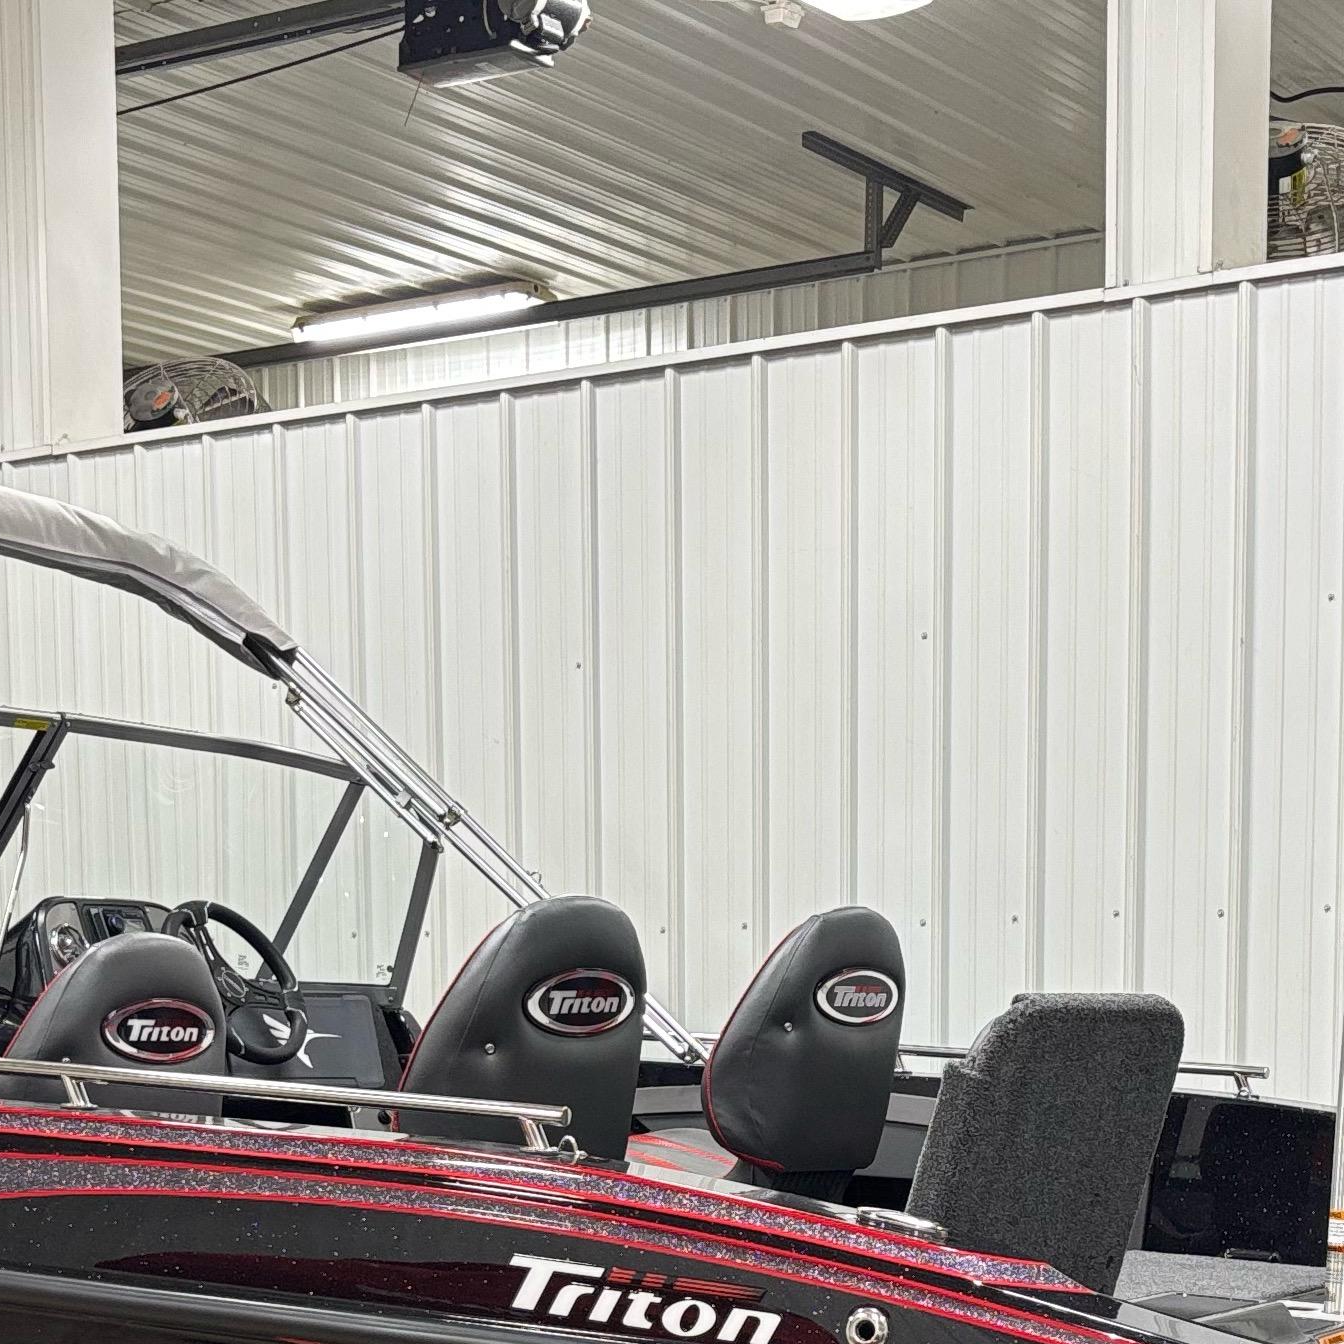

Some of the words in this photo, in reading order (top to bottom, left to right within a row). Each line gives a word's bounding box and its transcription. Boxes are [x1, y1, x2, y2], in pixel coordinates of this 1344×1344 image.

[548, 990, 620, 1015] Triton
[833, 985, 887, 1007] Triton
[127, 1018, 199, 1042] Triton
